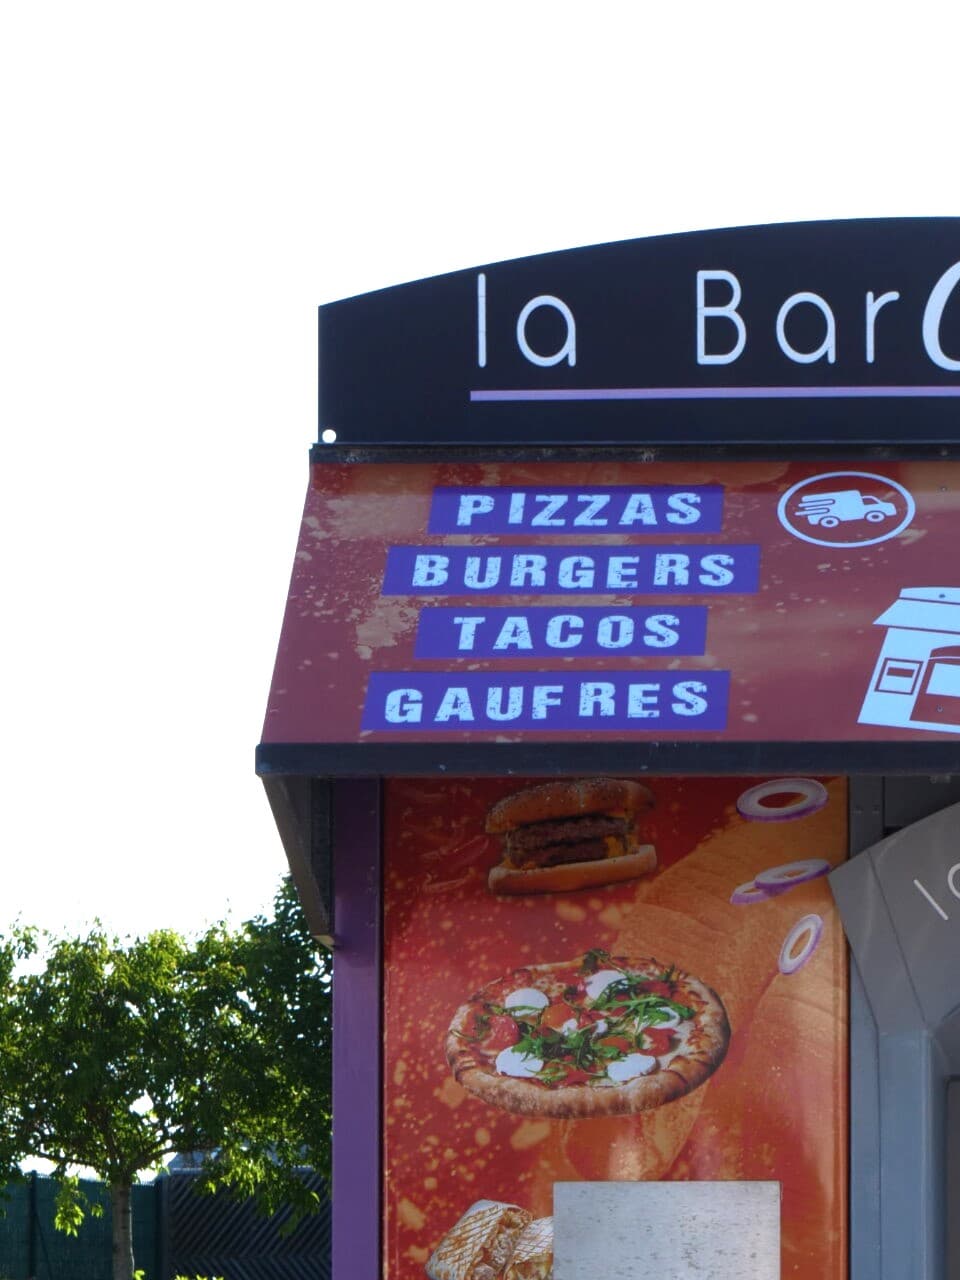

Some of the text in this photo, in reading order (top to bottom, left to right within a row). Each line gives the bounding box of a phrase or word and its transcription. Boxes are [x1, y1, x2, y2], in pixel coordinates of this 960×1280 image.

[477, 272, 577, 367] la
[456, 492, 702, 526] PIZZAS
[412, 553, 735, 589] BURGERS
[453, 614, 680, 650] TACOS
[384, 681, 709, 724] GAUFRES
